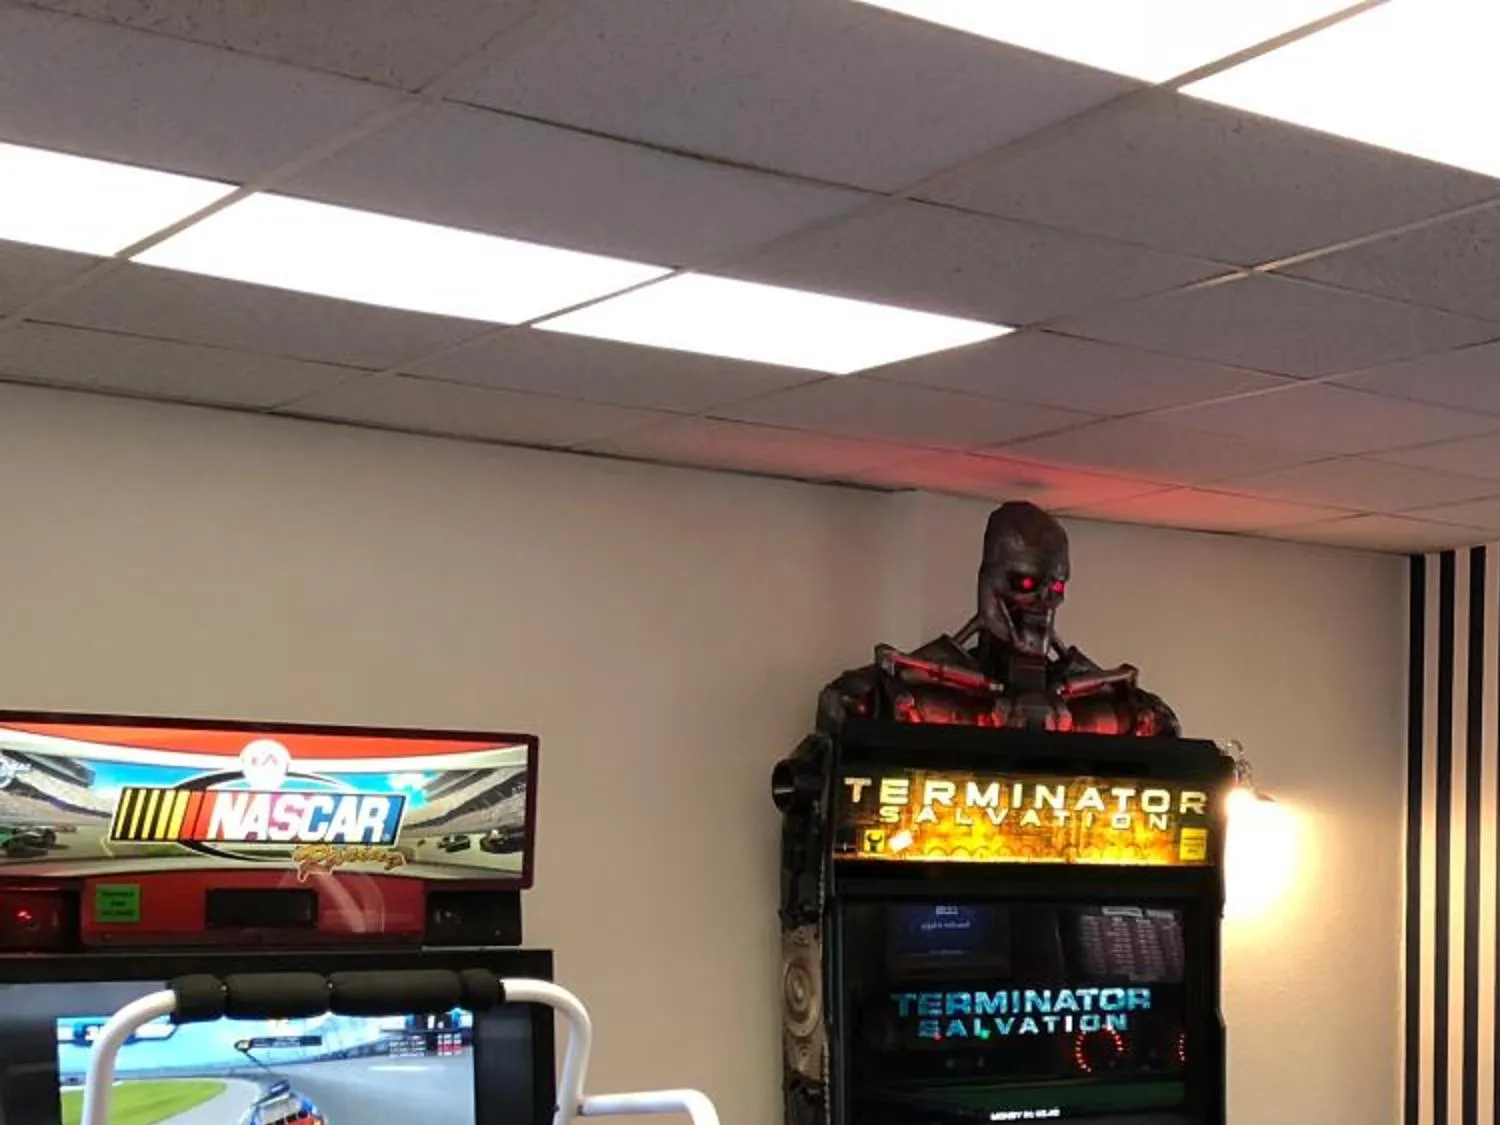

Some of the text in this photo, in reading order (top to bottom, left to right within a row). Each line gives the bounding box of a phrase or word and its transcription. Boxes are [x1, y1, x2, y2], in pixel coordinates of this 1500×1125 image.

[844, 777, 1209, 815] TERMINATOR
[207, 790, 390, 843] NASCAR
[879, 805, 1169, 831] SALVATION
[891, 988, 1152, 1017] TERMINATOR
[918, 1014, 1128, 1038] SALVATION
